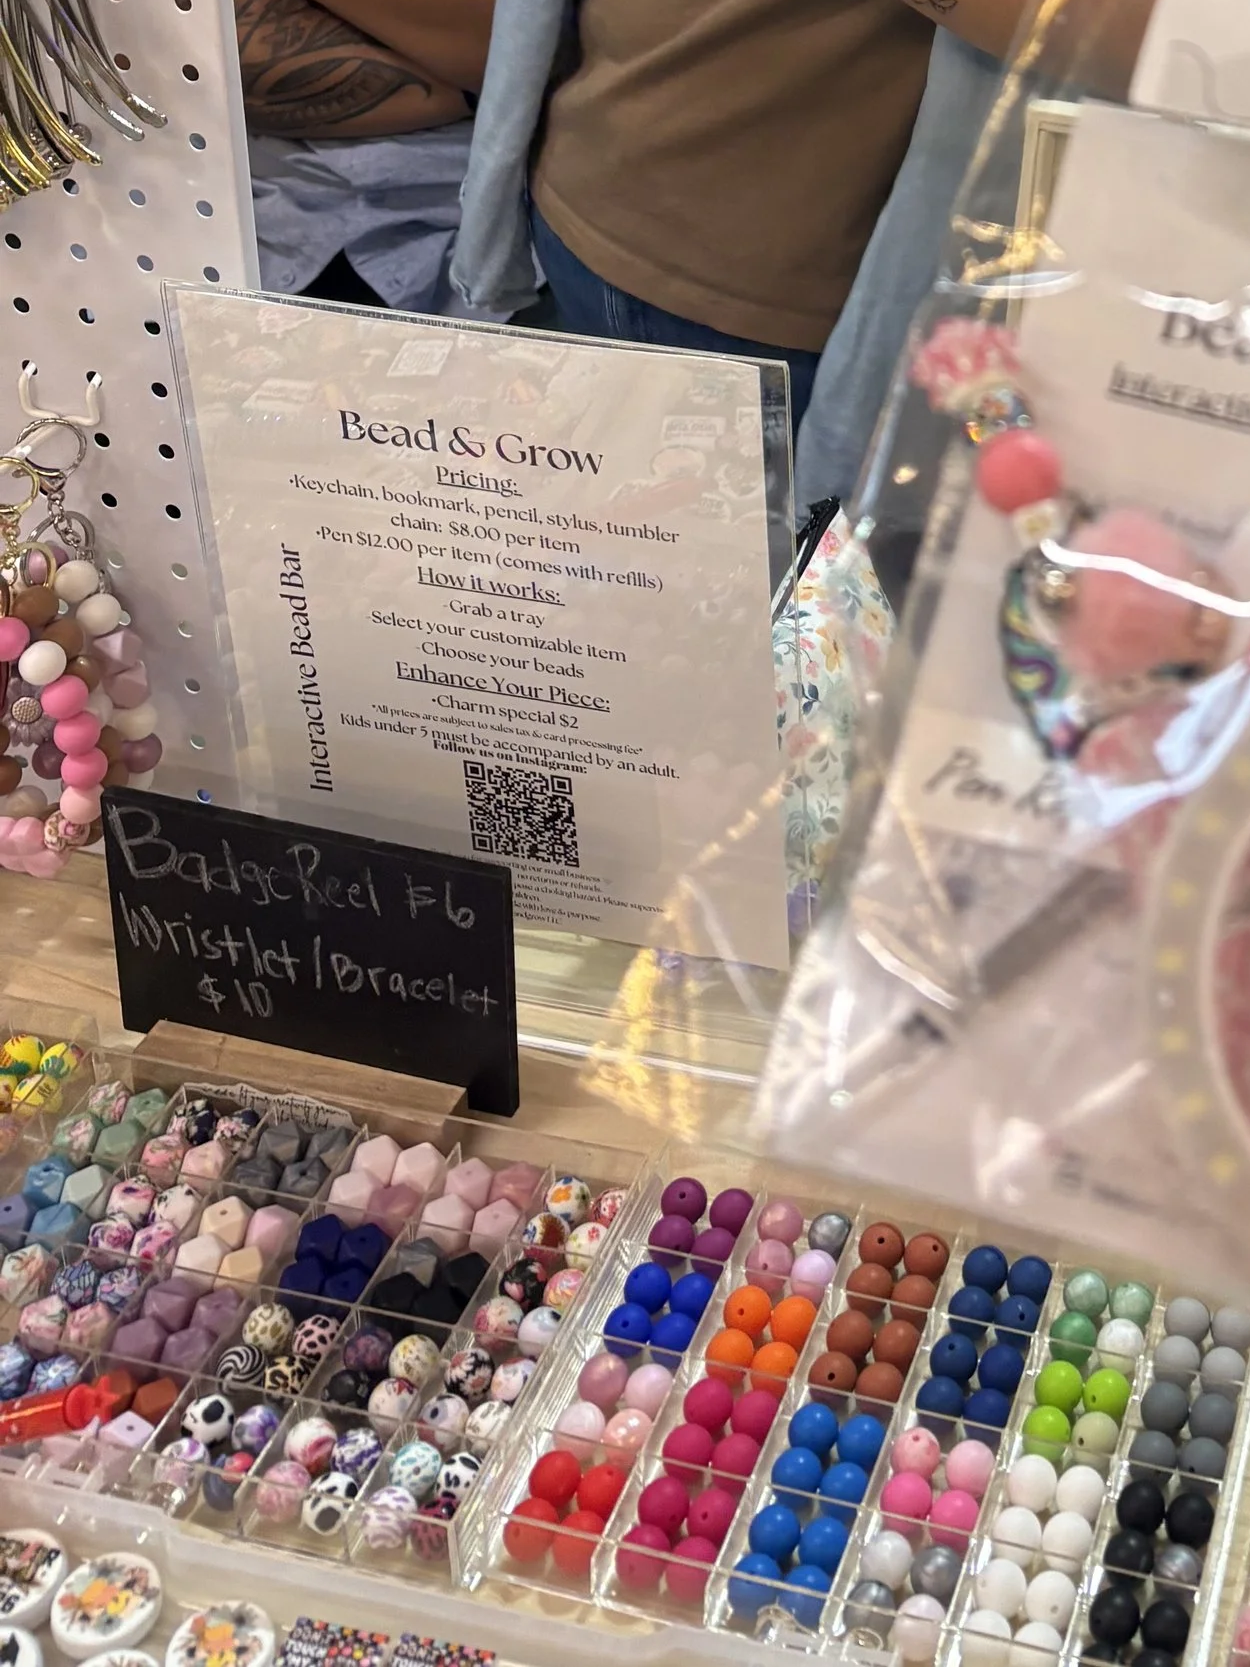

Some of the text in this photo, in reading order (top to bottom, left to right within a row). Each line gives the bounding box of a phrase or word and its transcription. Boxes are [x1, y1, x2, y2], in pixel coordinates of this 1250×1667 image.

[338, 409, 604, 476] Bead & Grow
[435, 465, 520, 498] Pricing:
[382, 485, 480, 518] bookmark,
[484, 502, 544, 525] pencil,
[546, 512, 603, 535] stylus,
[606, 520, 680, 544] tumbler
[390, 513, 581, 555] chain: $8.00 per item
[356, 531, 413, 553] $12.00
[417, 543, 448, 560] per
[451, 546, 492, 566] item
[495, 552, 562, 576] (comes
[565, 561, 603, 582] with
[416, 566, 563, 605] How it works:
[496, 609, 508, 620] a
[510, 609, 546, 629] tray
[426, 621, 466, 639] your
[470, 625, 584, 656] customizable
[586, 644, 627, 663] item
[279, 542, 334, 793] Interactive Bead Bar
[396, 661, 611, 712] Enhance Your Piece:
[489, 654, 530, 672] your
[534, 656, 585, 679] beads
[390, 708, 422, 721] prices
[423, 713, 439, 723] are
[440, 715, 475, 730] subject
[477, 720, 488, 729] to
[489, 722, 514, 733] sales
[543, 731, 567, 743] card
[568, 735, 623, 755] processing
[498, 705, 556, 727] special
[559, 713, 580, 730] $2
[340, 712, 680, 780] Kids under 5 must be accompanied by an adult.
[433, 739, 588, 776] Follow us on Instagram:
[199, 973, 274, 1018] $10
